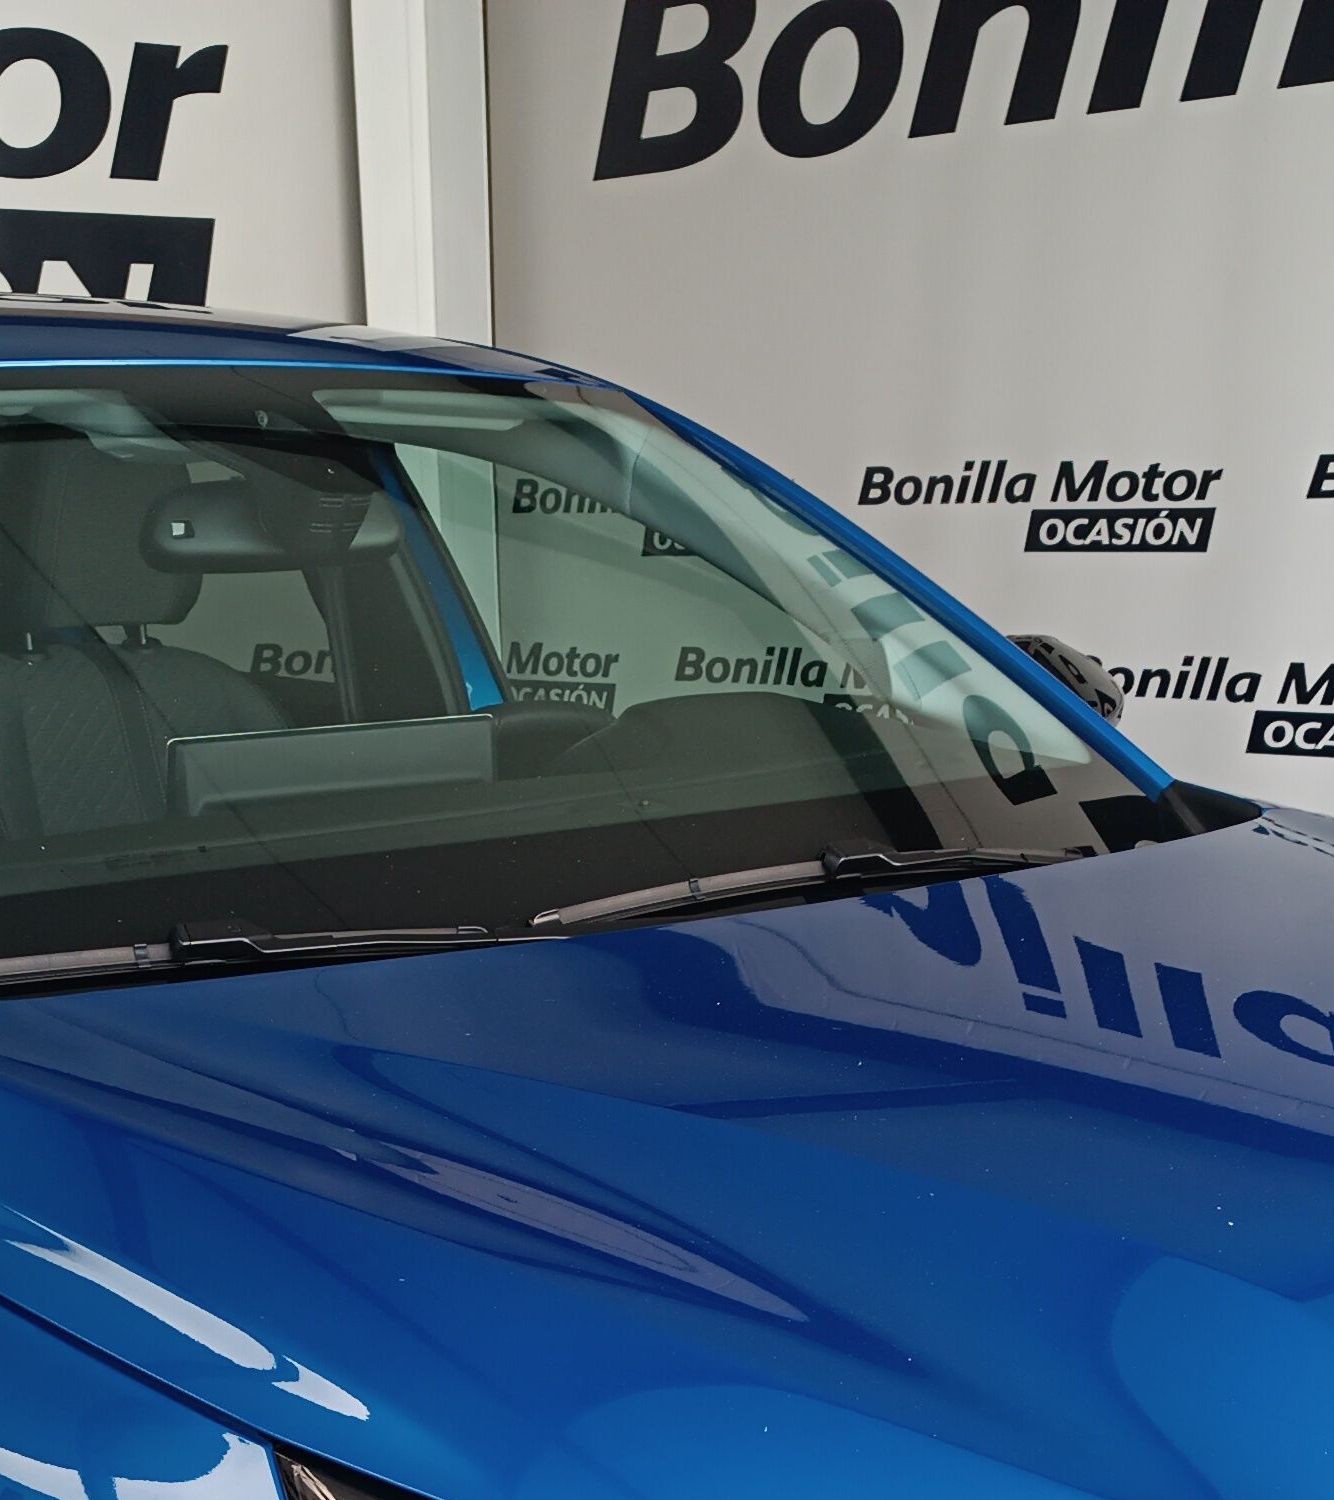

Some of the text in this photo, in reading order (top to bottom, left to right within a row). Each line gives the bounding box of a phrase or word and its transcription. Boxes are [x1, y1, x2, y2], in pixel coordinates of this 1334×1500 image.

[858, 460, 1223, 505] Bonilla Motor
[1039, 511, 1202, 546] OCASIÓN
[506, 641, 620, 678] Motor
[676, 646, 828, 688] Bonilla
